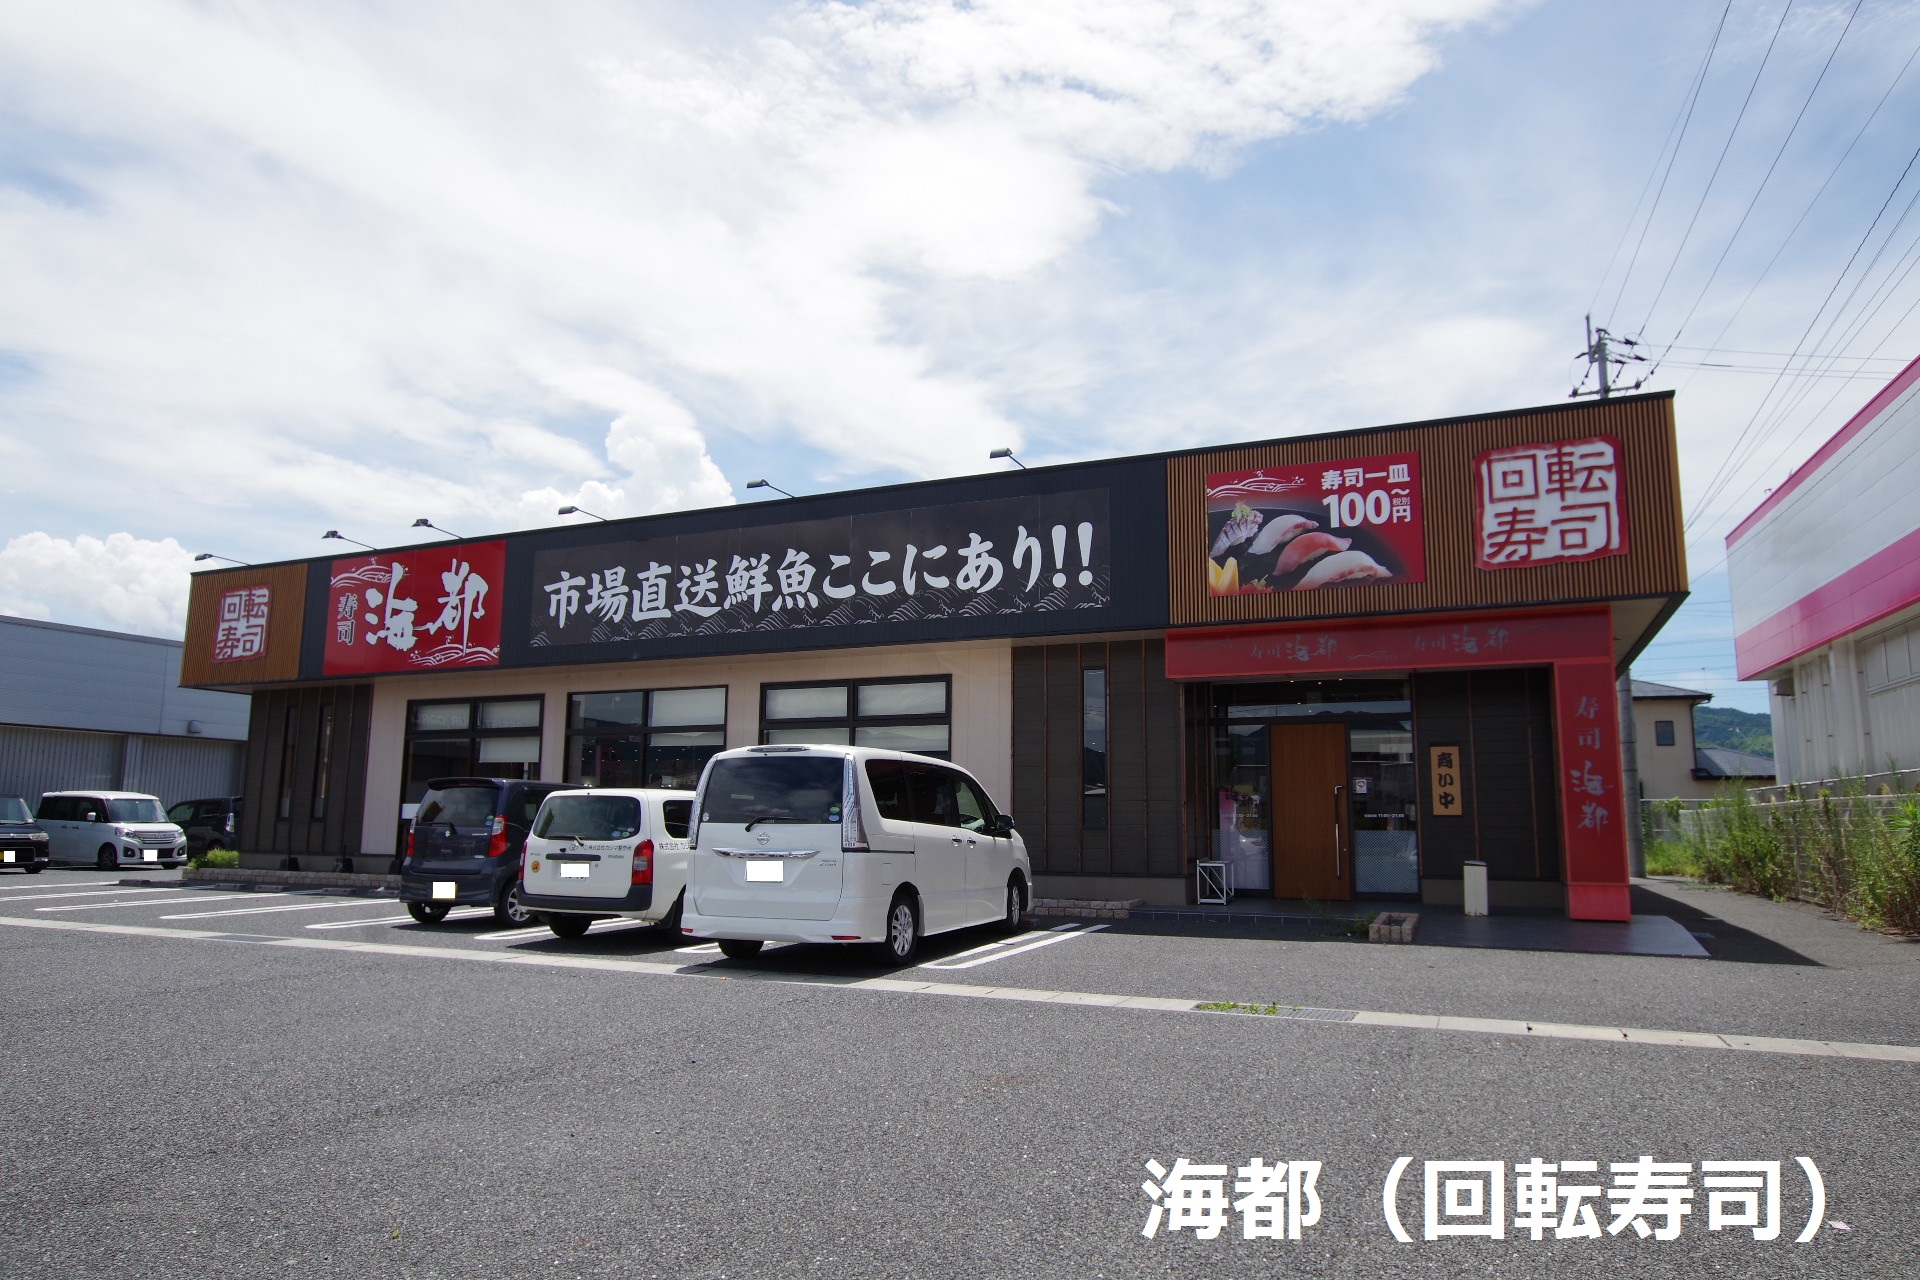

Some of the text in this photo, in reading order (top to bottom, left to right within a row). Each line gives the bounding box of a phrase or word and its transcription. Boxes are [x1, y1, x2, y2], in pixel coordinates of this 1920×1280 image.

[1321, 464, 1410, 490] 寿司一皿
[1488, 445, 1614, 503] 回転
[1488, 503, 1609, 561] 寿司
[543, 521, 1094, 628] 市場直送鮮魚ここにあり!!
[337, 592, 358, 646] 寿司
[365, 558, 489, 656] 海都
[1436, 752, 1455, 810] 商い中
